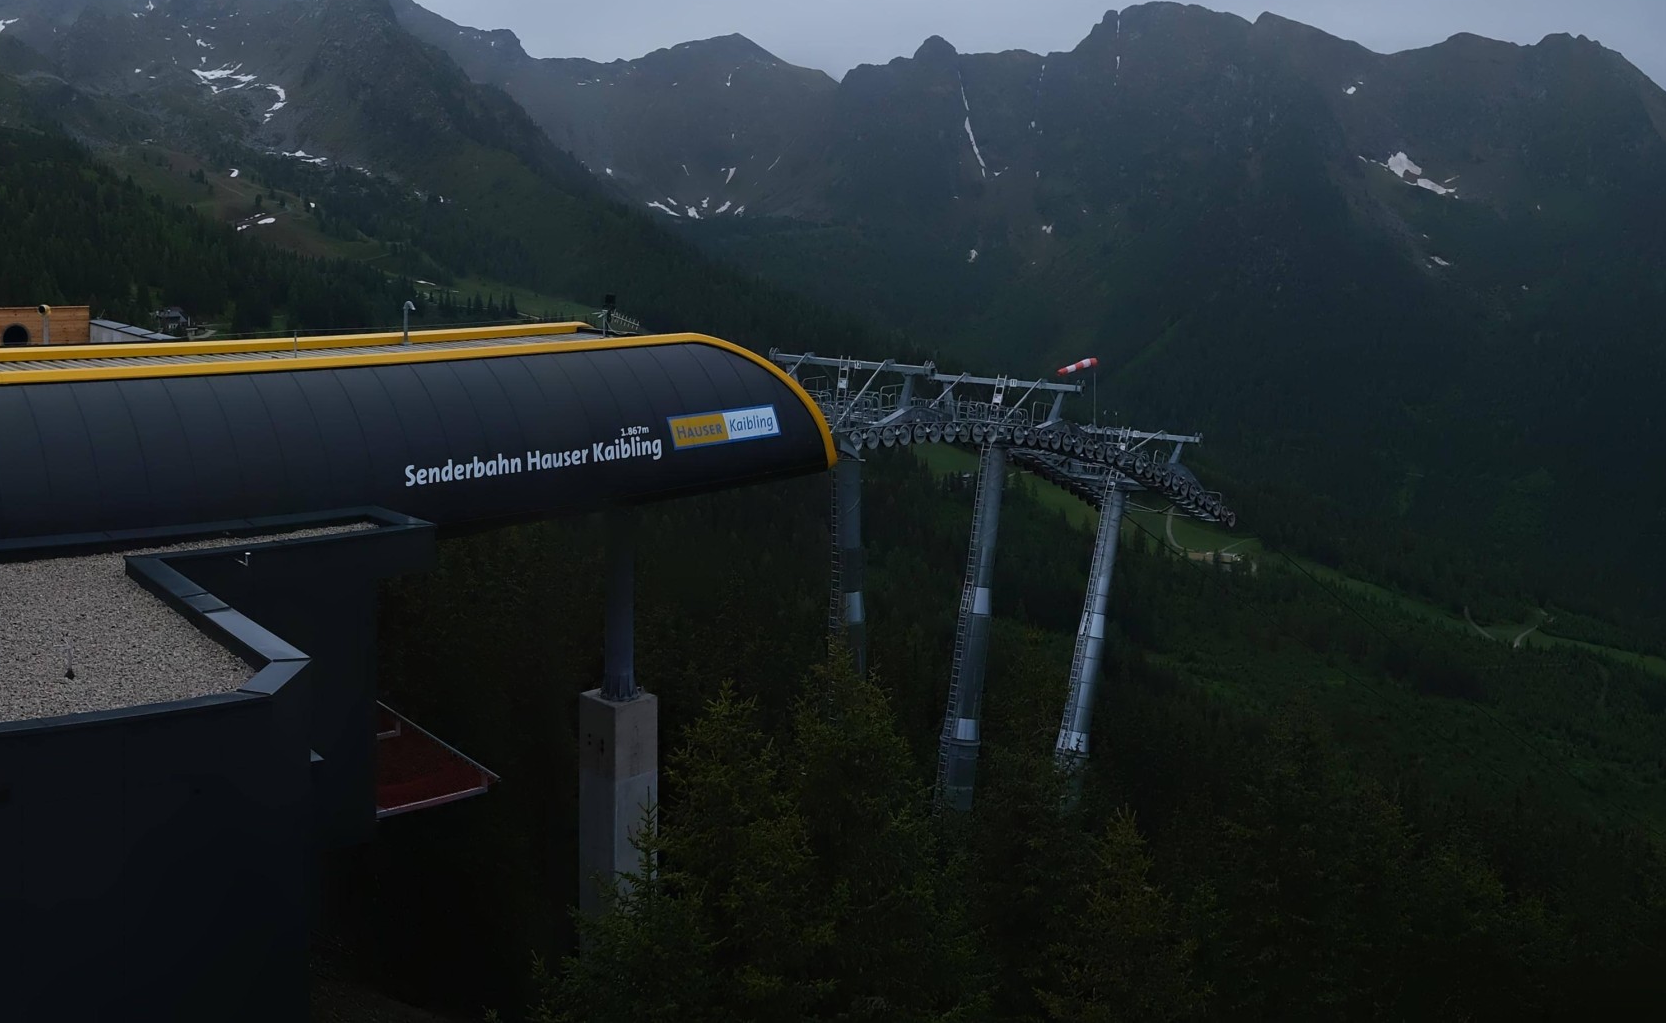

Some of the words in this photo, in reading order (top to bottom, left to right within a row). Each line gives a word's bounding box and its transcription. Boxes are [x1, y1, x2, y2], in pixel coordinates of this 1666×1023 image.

[620, 426, 649, 436] 1.867m
[729, 416, 773, 433] Kaibling
[405, 453, 521, 487] Senderbahn
[527, 448, 588, 471] Hauser
[592, 436, 662, 462] Kaibling
